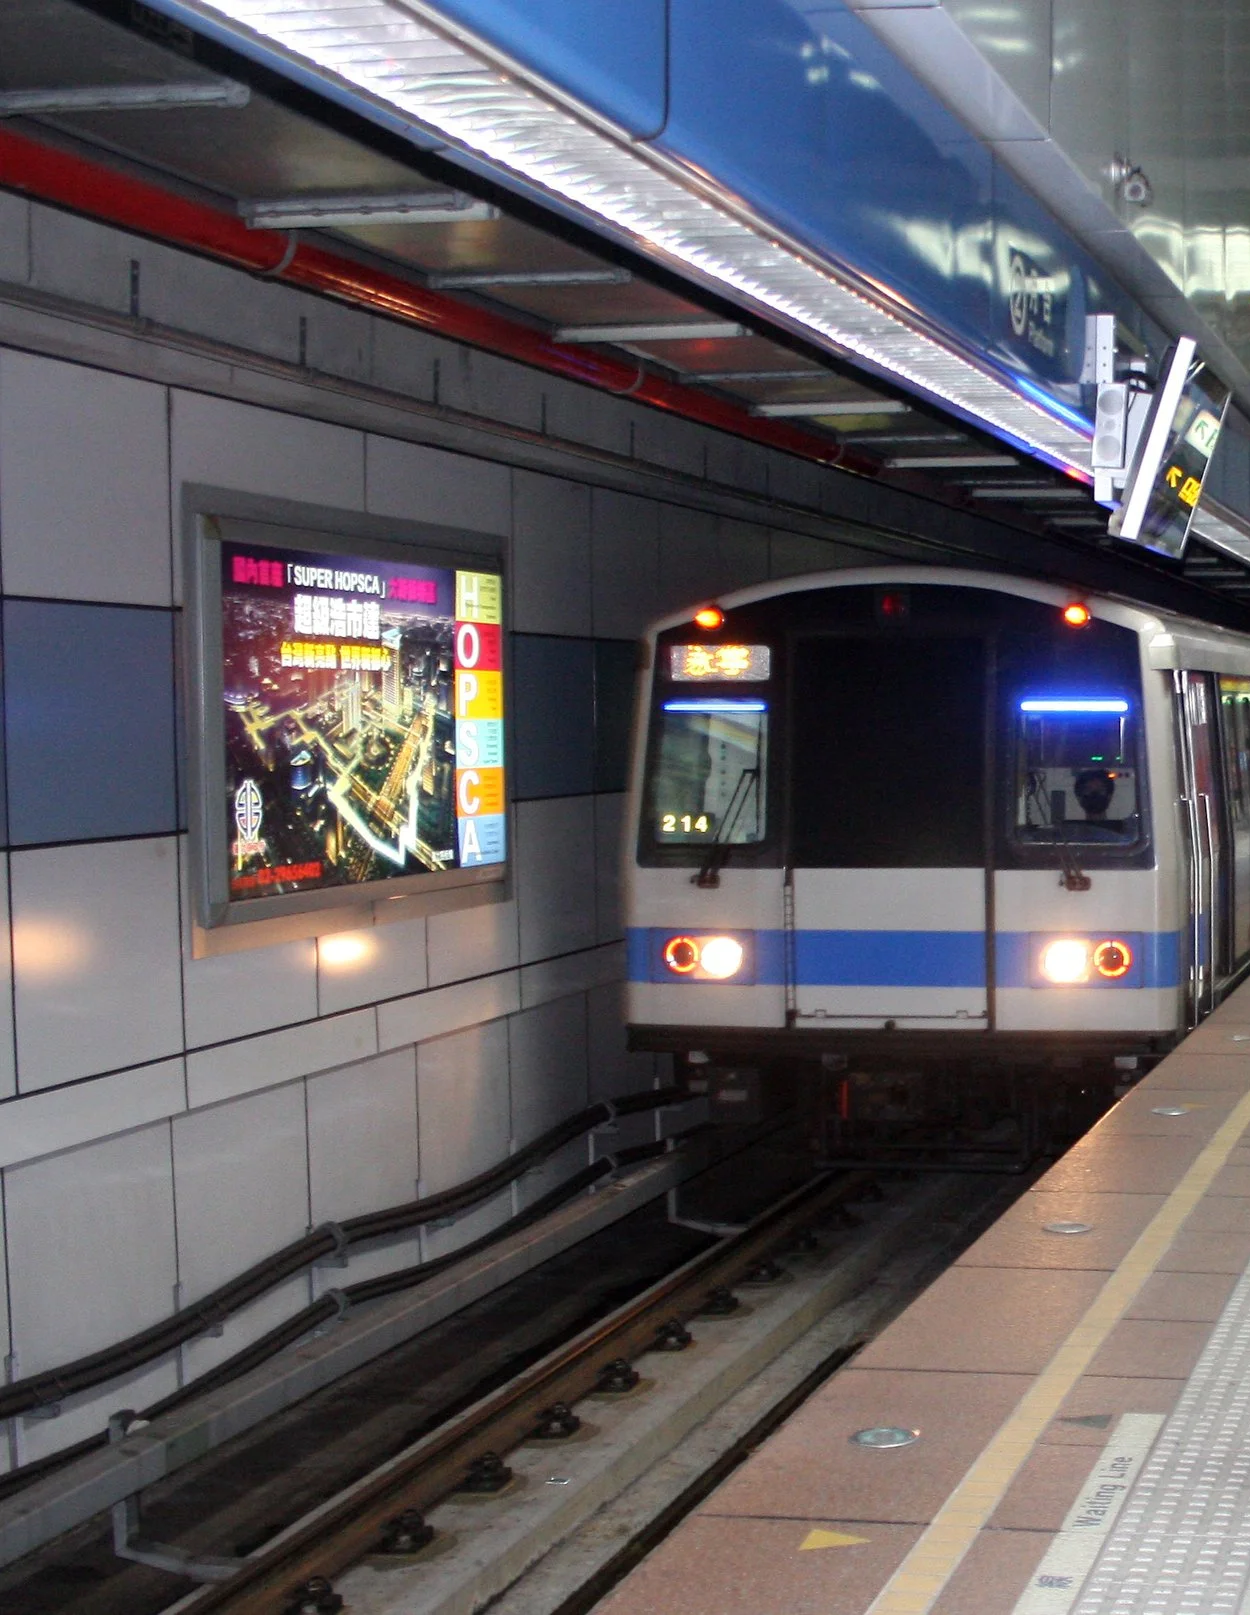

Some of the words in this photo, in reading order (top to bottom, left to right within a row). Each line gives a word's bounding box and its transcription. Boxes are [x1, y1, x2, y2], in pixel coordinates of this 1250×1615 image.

[293, 565, 333, 590] SUPER
[334, 570, 381, 595] HOPSCA
[662, 814, 708, 833] 214
[1098, 1456, 1133, 1480] Line
[1072, 1484, 1127, 1528] Waiting
